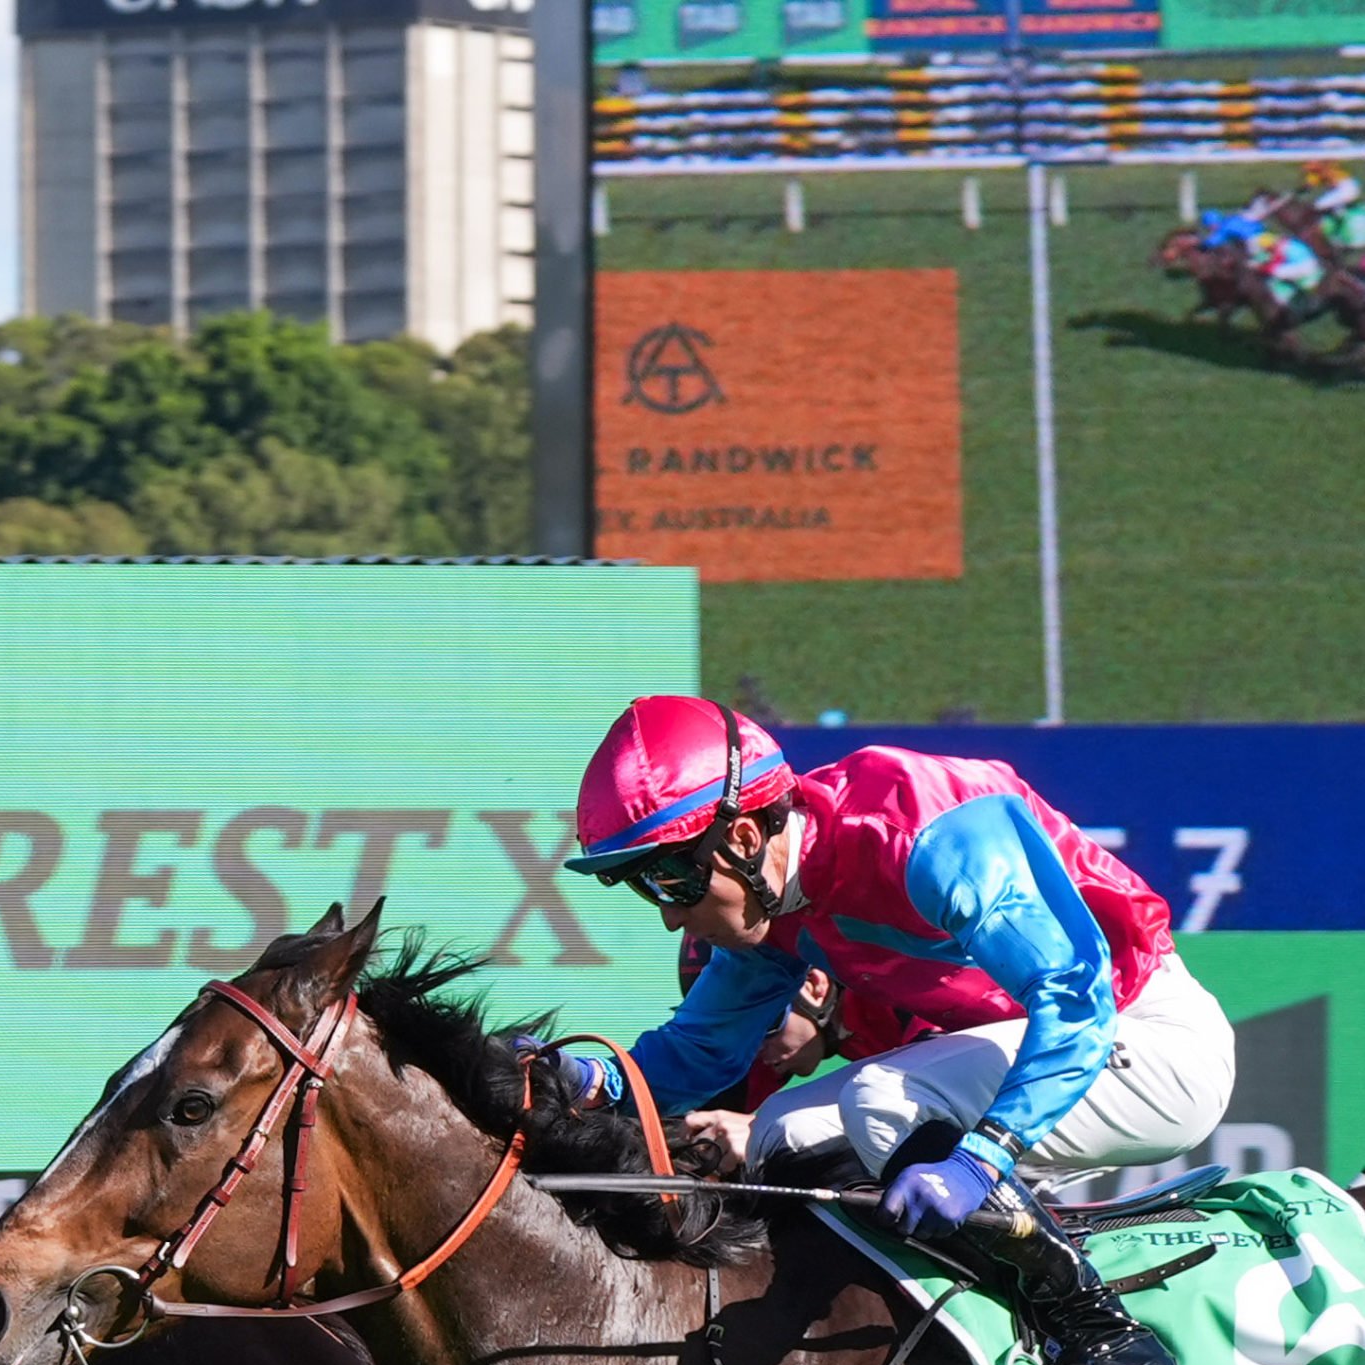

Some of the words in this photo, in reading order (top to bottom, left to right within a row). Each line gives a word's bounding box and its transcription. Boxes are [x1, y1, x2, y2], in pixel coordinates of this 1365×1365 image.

[626, 443, 878, 475] RANDWICK
[652, 506, 832, 532] AUSTRALIA
[473, 809, 614, 967] X
[1175, 827, 1249, 933] 7
[1142, 1230, 1203, 1246] THE
